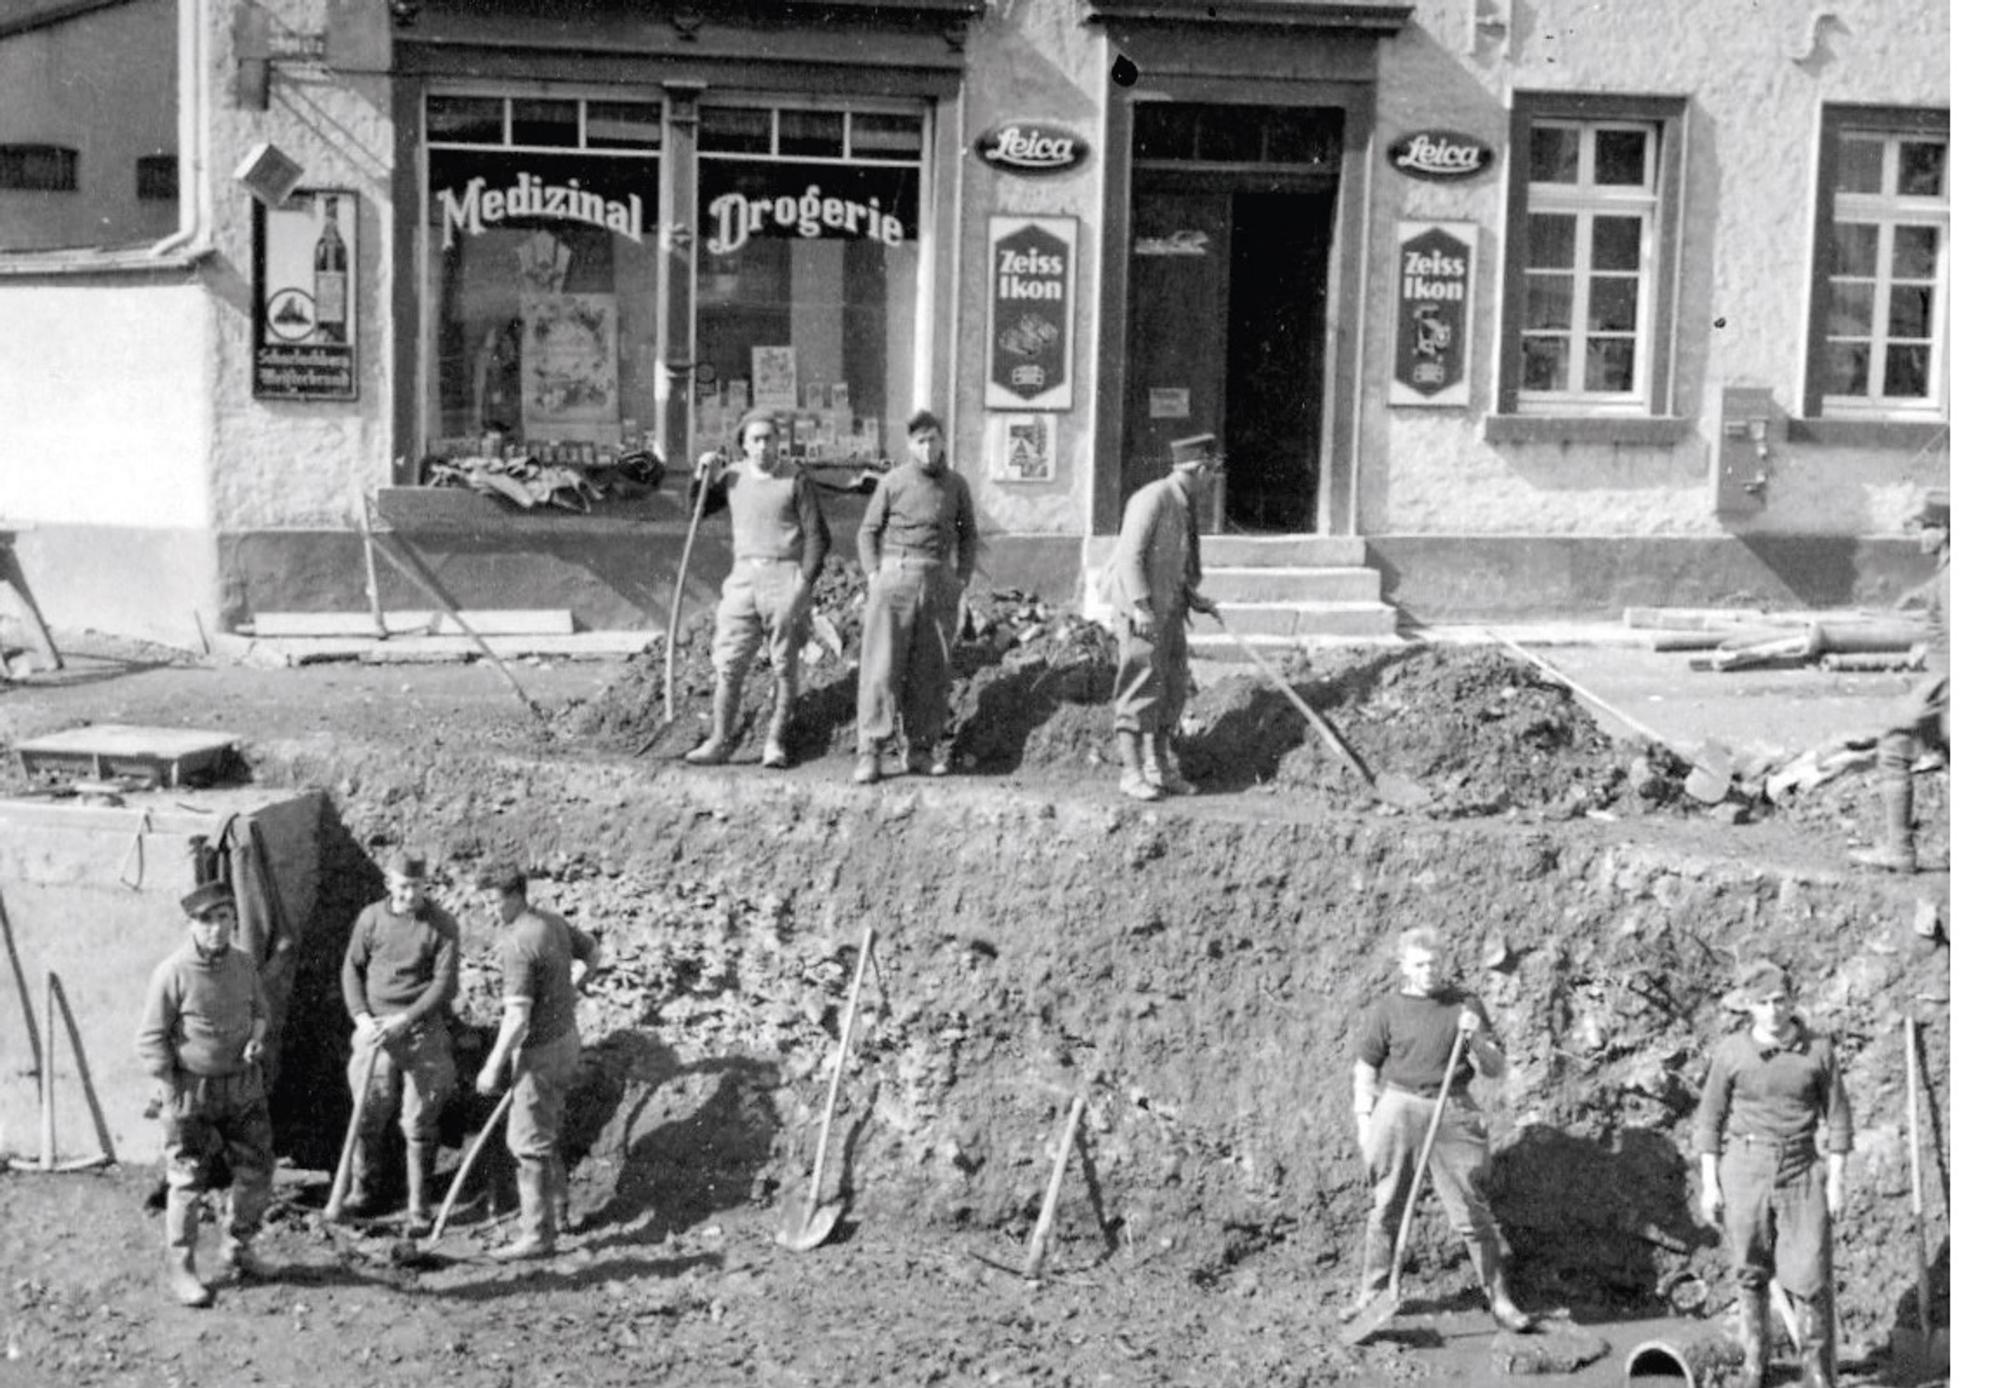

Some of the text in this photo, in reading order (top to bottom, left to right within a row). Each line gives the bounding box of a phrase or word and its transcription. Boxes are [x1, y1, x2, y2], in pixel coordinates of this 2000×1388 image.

[985, 127, 1075, 166] Leica
[1397, 134, 1482, 172] Leica
[436, 171, 642, 250] Medizinal
[706, 184, 903, 254] Drogerie
[1000, 248, 1063, 275] Zeiss
[1404, 250, 1465, 276] Zeiss
[1000, 276, 1062, 299] Ikon
[1403, 276, 1464, 299] Ikon
